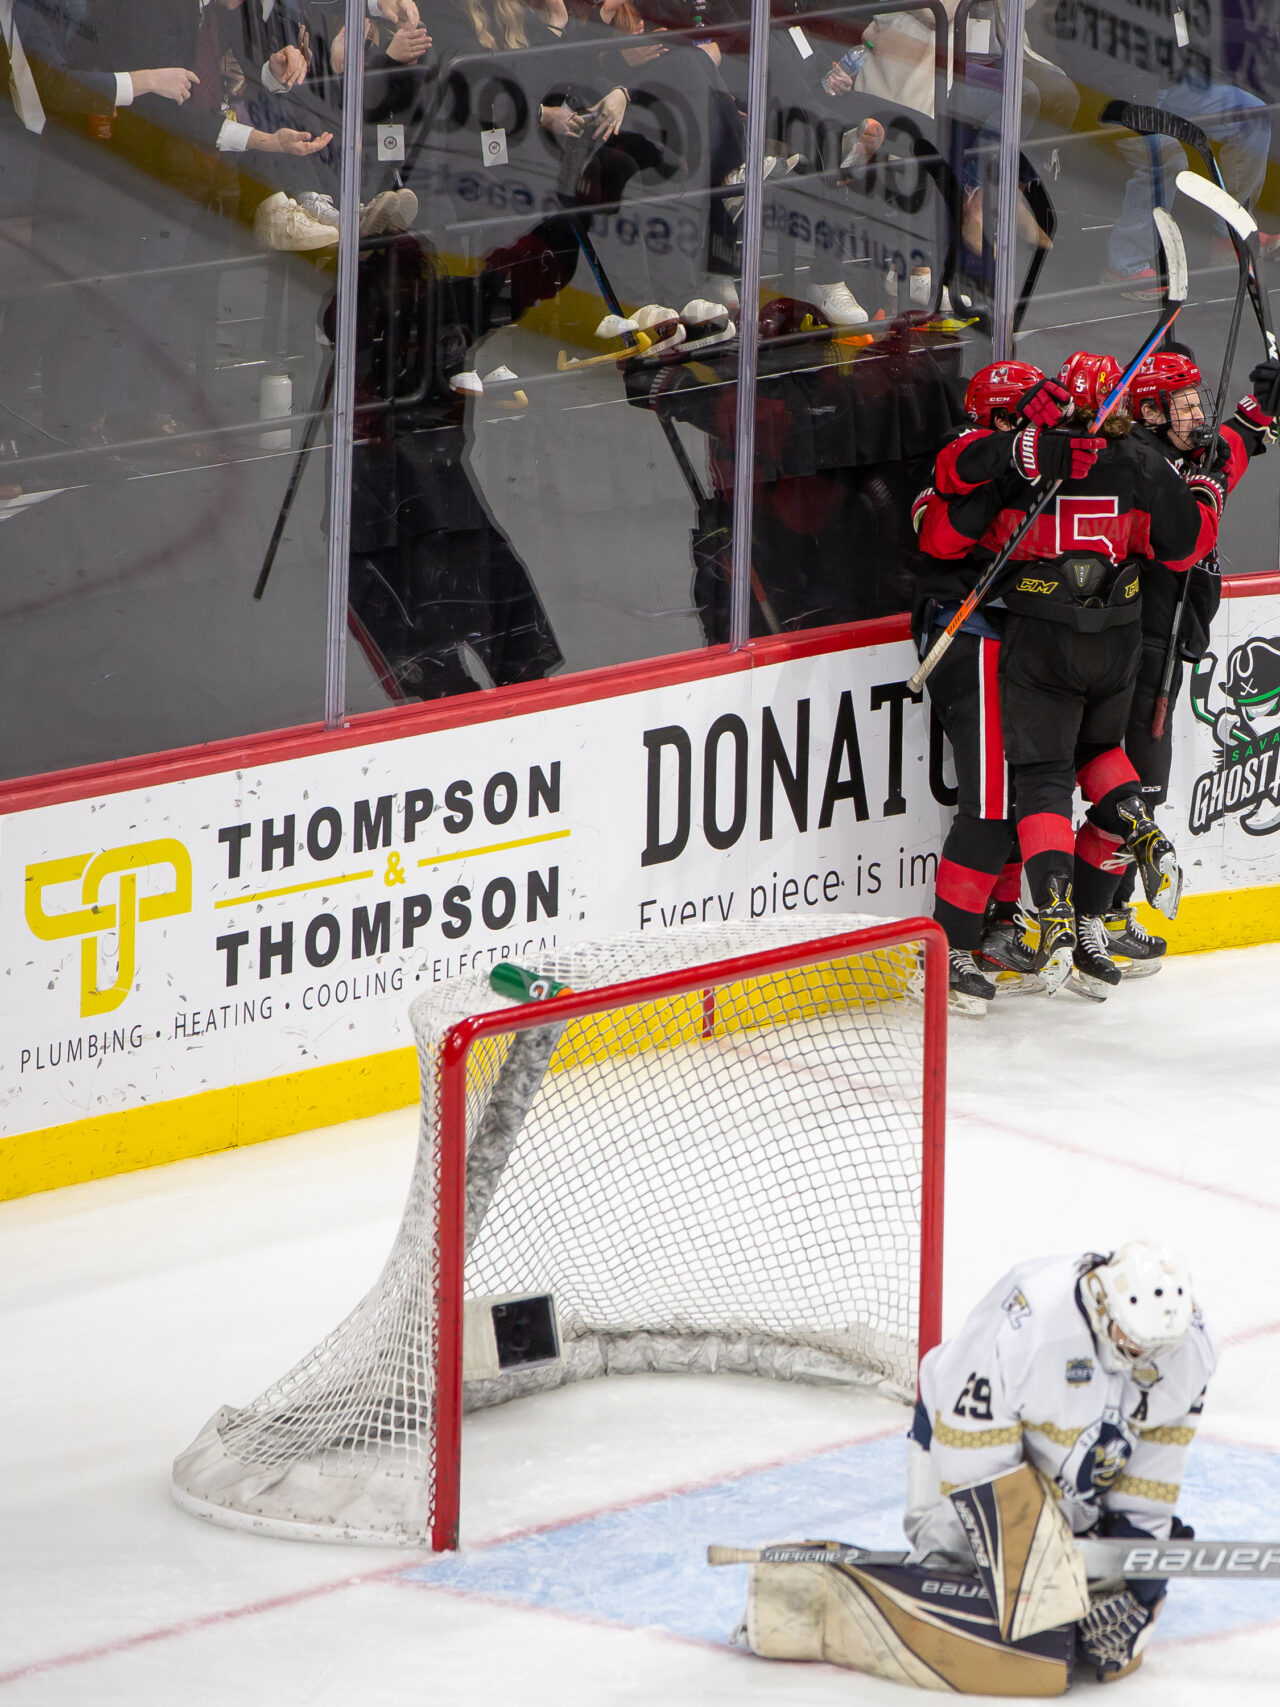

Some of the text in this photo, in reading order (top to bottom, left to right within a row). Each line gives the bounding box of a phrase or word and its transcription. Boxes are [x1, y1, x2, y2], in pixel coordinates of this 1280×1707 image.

[217, 760, 563, 879] THOMPSON
[215, 864, 561, 988] THOMPSON
[750, 869, 841, 919] piece
[856, 853, 882, 897] is
[19, 1022, 145, 1074] PLUMBING
[173, 995, 274, 1040] HEATING
[302, 966, 405, 1011] COOLING
